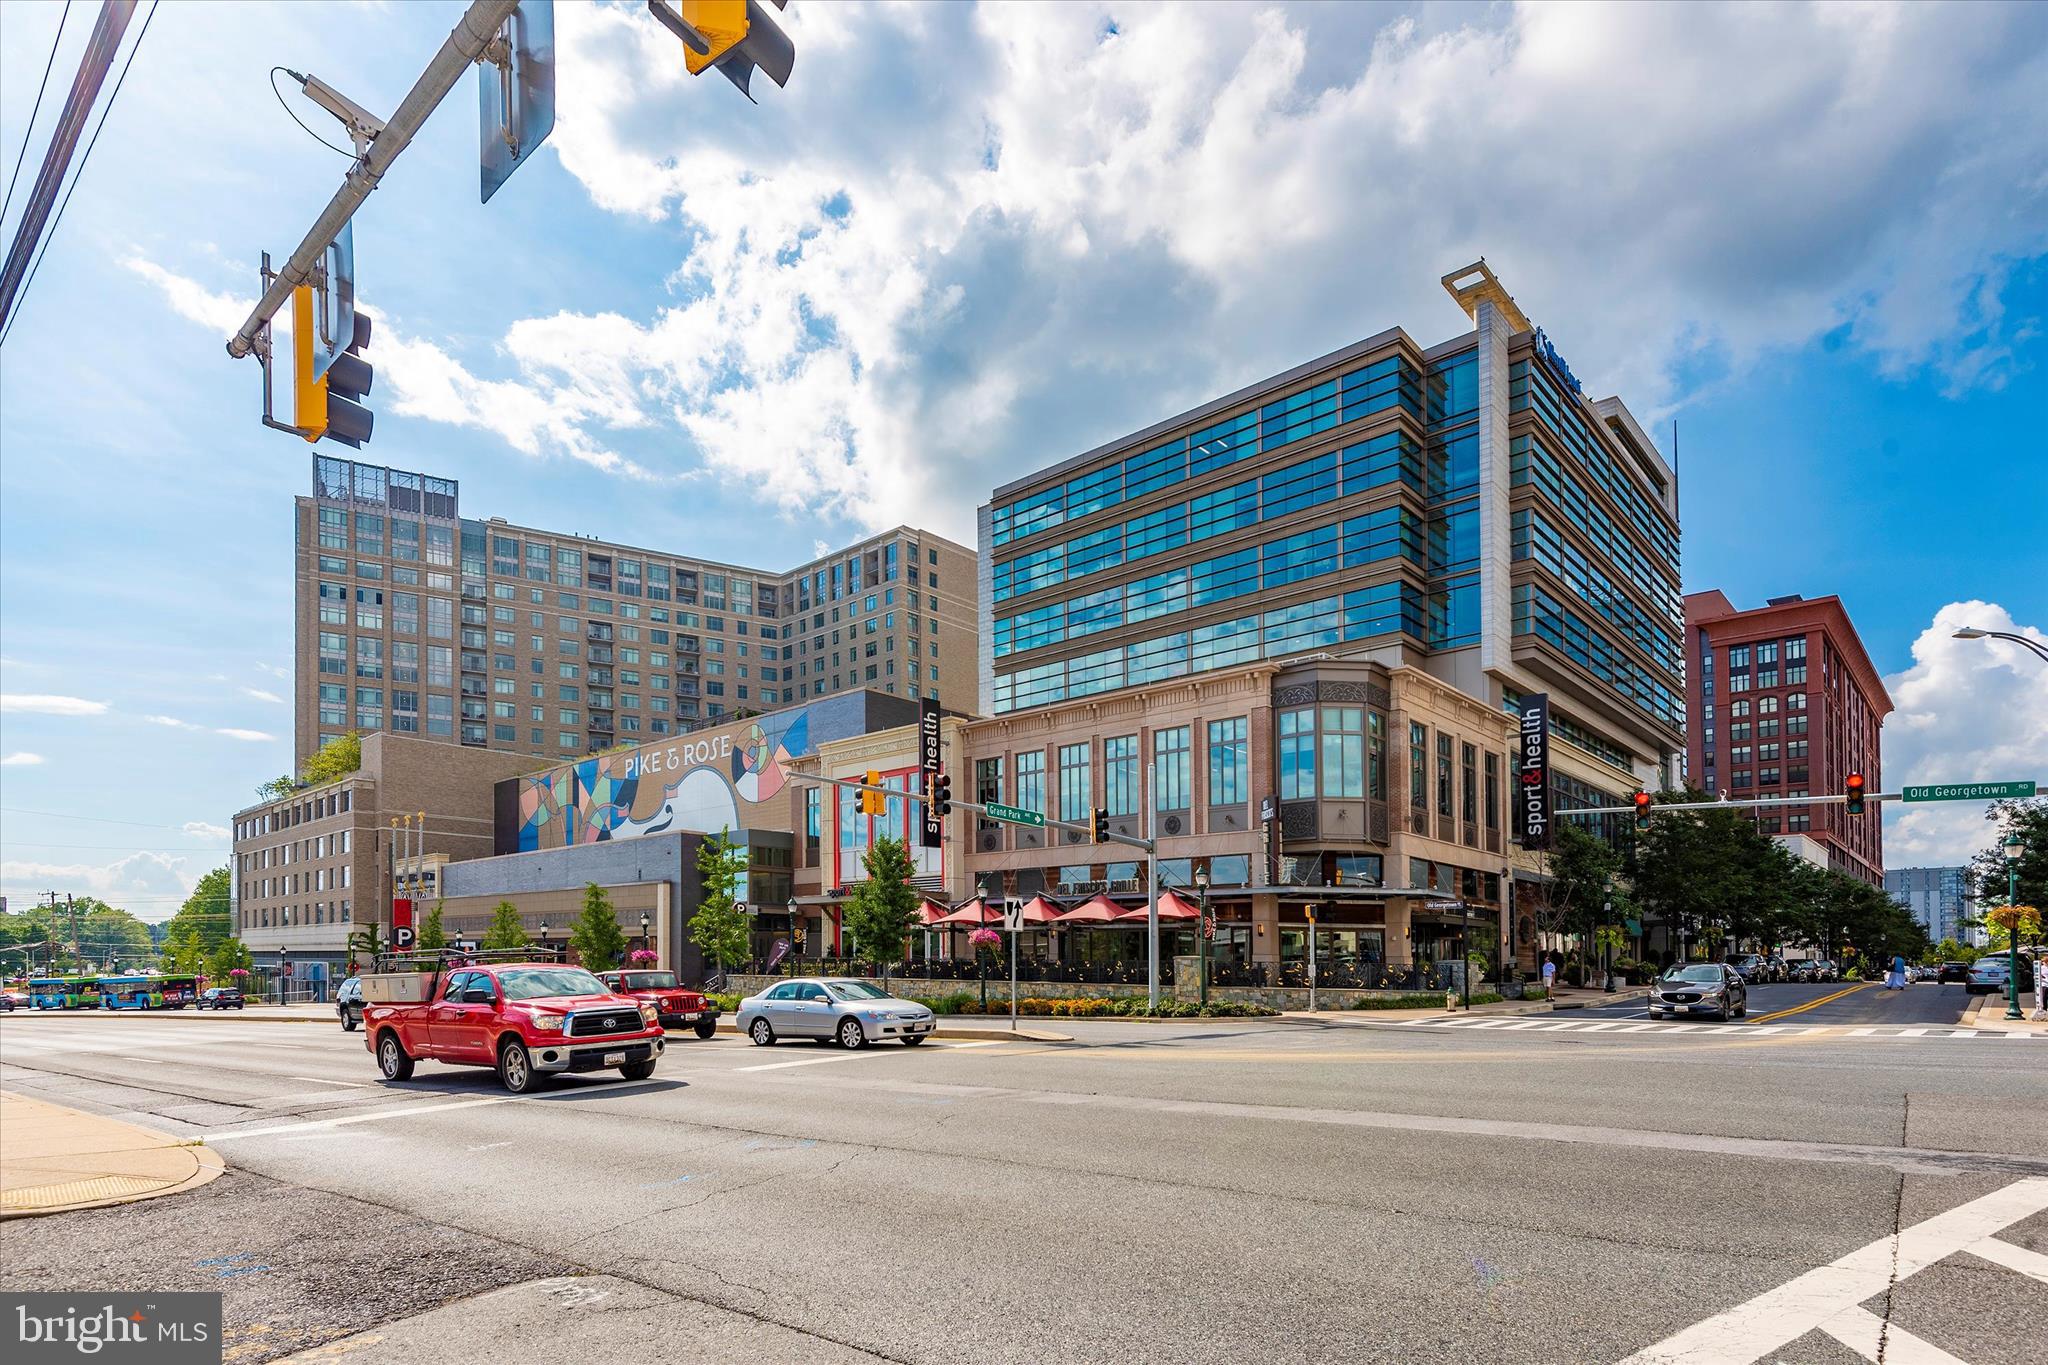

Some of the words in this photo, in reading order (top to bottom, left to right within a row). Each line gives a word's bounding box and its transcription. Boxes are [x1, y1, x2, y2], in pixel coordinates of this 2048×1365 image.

[625, 751, 661, 778] PIKE
[667, 747, 679, 770] &
[684, 735, 731, 766] ROSE
[923, 712, 940, 833] sphealth
[1522, 708, 1547, 835] sport&health
[1910, 788, 1929, 798] Old
[1935, 785, 2007, 798] Georgetown
[989, 805, 1006, 817] Grand
[1008, 809, 1021, 820] Park
[1057, 882, 1072, 896] DEL
[1072, 879, 1109, 896] FRISCO'S
[1111, 878, 1140, 893] GRILLE
[398, 929, 412, 945] P
